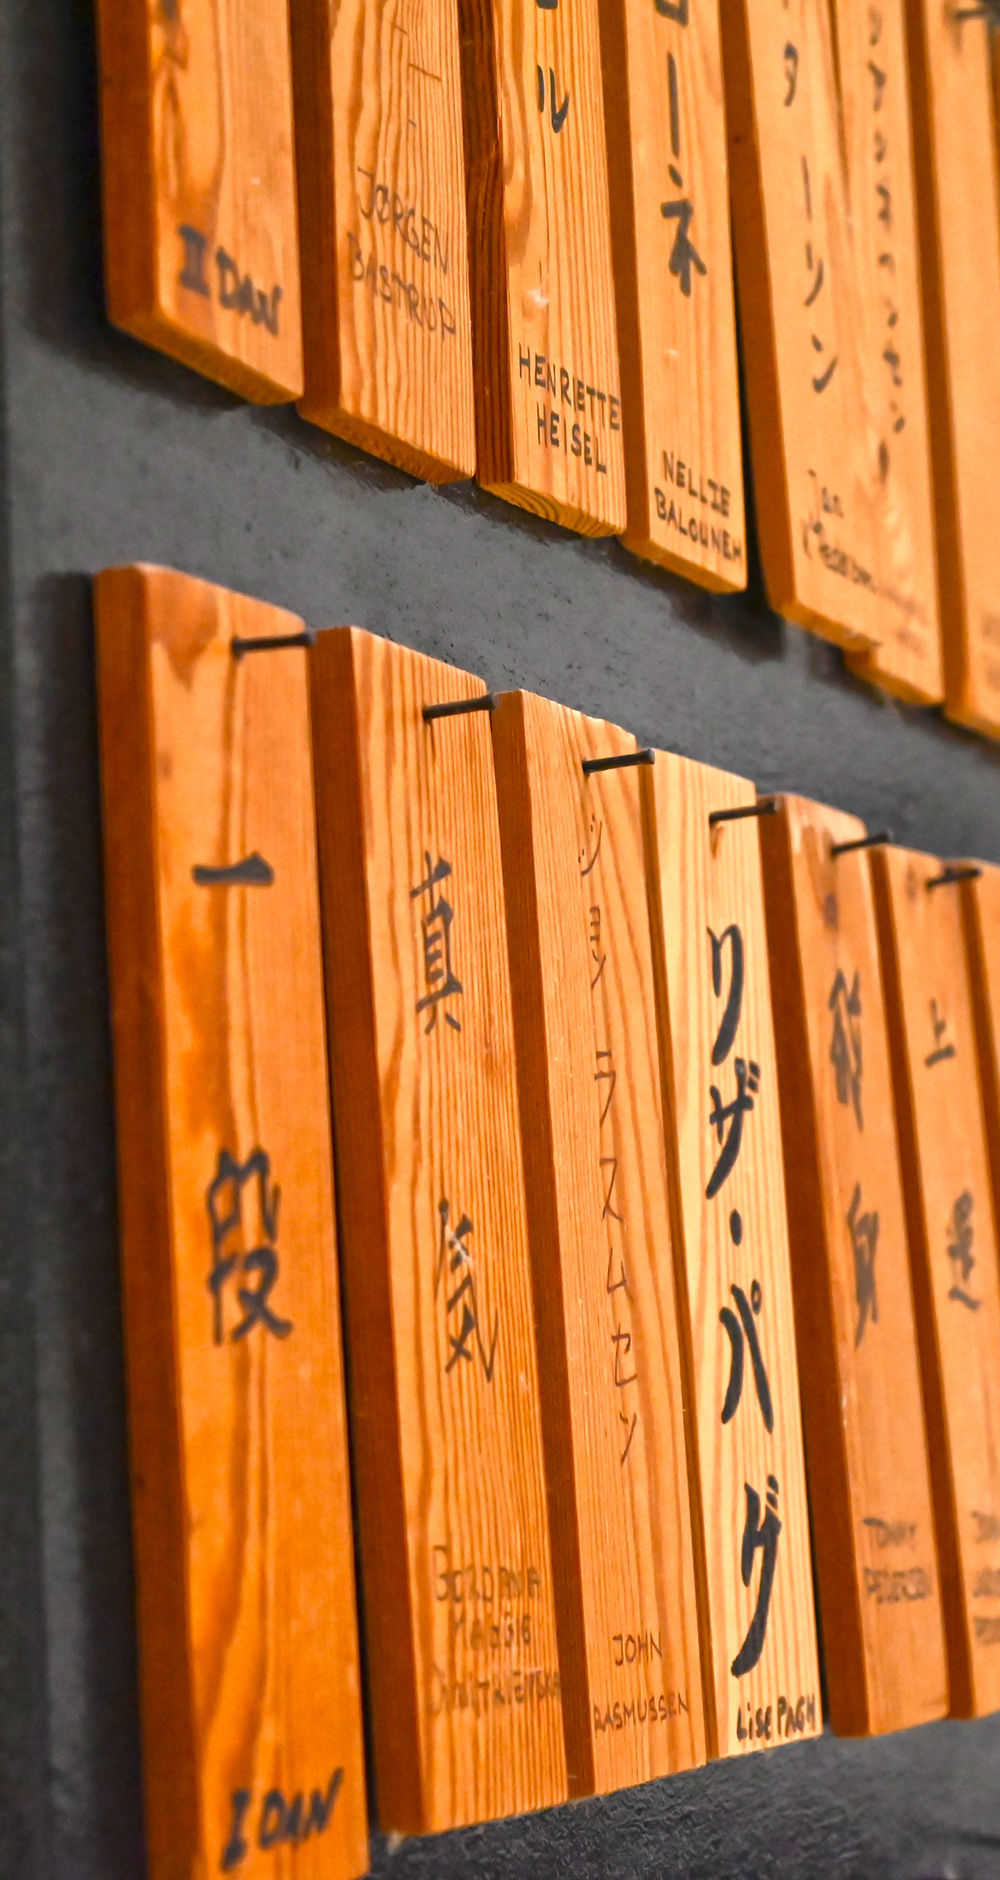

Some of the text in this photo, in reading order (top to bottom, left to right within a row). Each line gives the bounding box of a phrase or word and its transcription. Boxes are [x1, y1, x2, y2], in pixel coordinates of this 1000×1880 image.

[518, 342, 621, 431] HENRIETTE
[536, 401, 608, 475] HEISEL
[662, 450, 731, 518] NELLIE
[612, 1628, 663, 1667] JOHN
[592, 1691, 690, 1734] RASMUSSEN
[777, 1693, 816, 1739] PAGH
